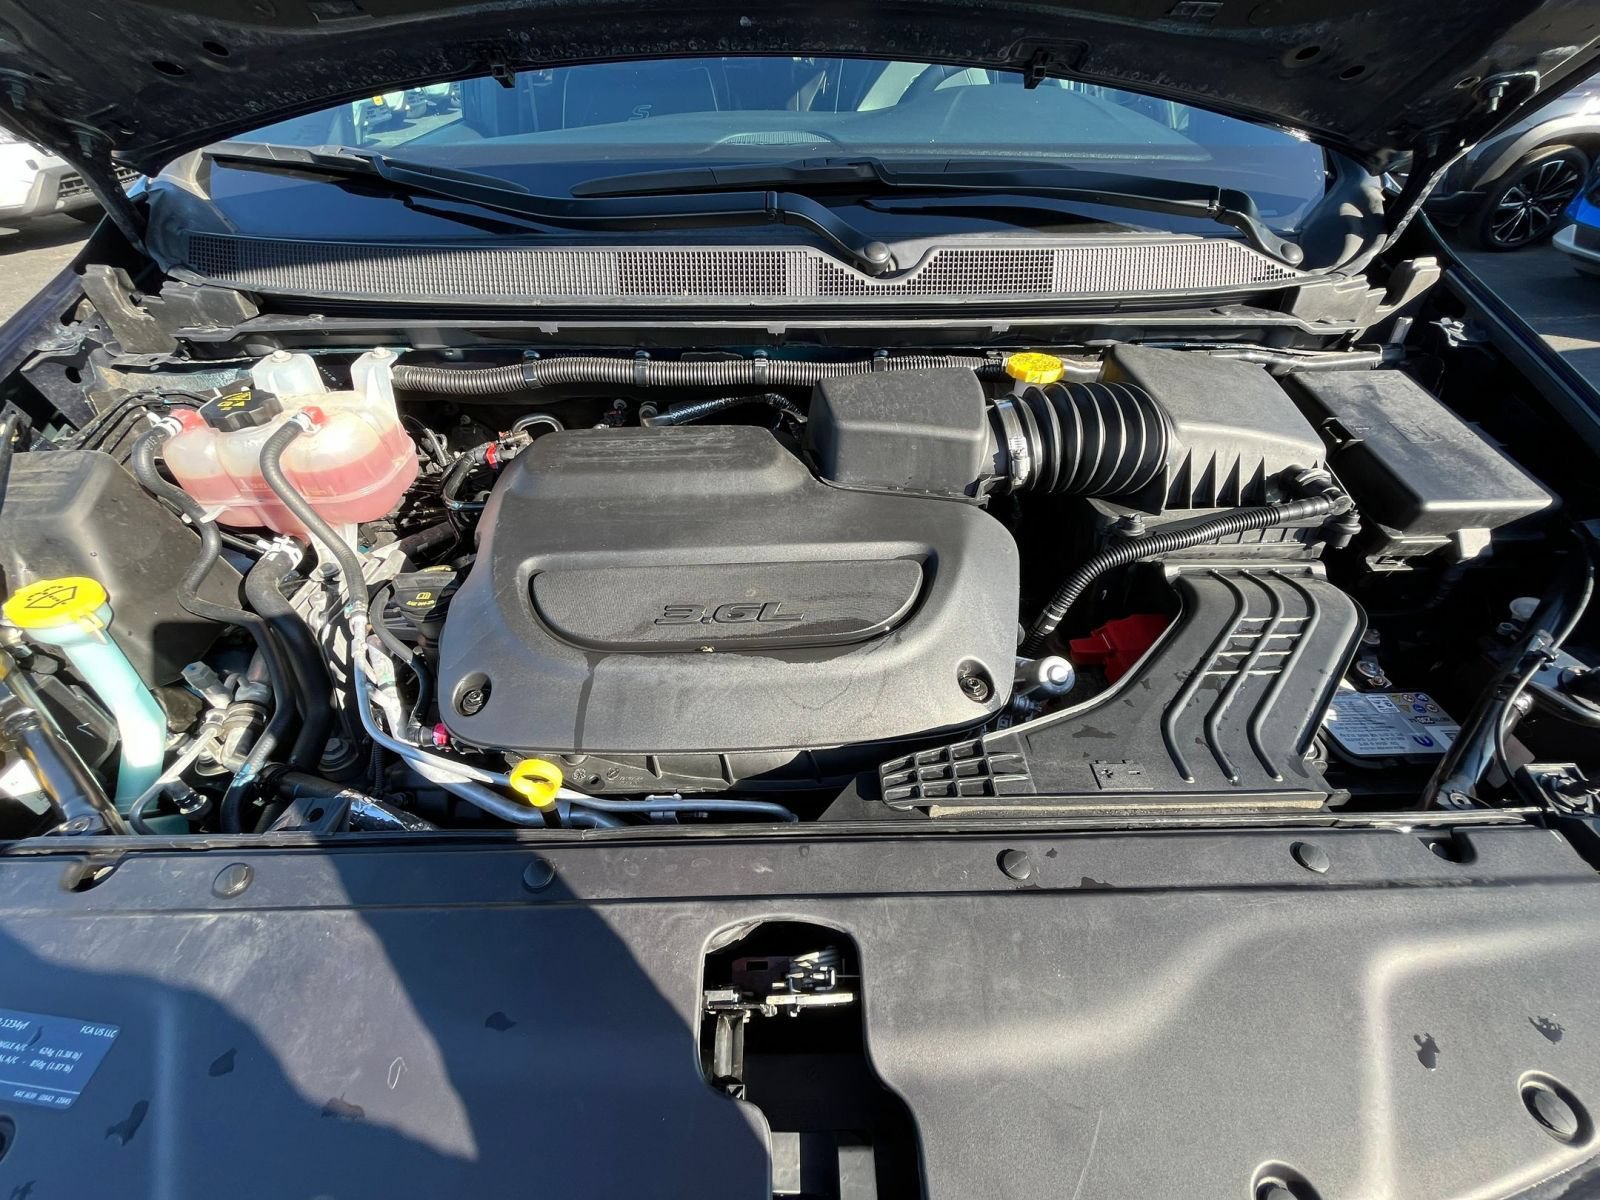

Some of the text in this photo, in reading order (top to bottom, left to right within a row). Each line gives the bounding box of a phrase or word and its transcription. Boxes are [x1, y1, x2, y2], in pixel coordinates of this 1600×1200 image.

[654, 601, 804, 625] 3.6L
[80, 1025, 119, 1039] FCA US LLC
